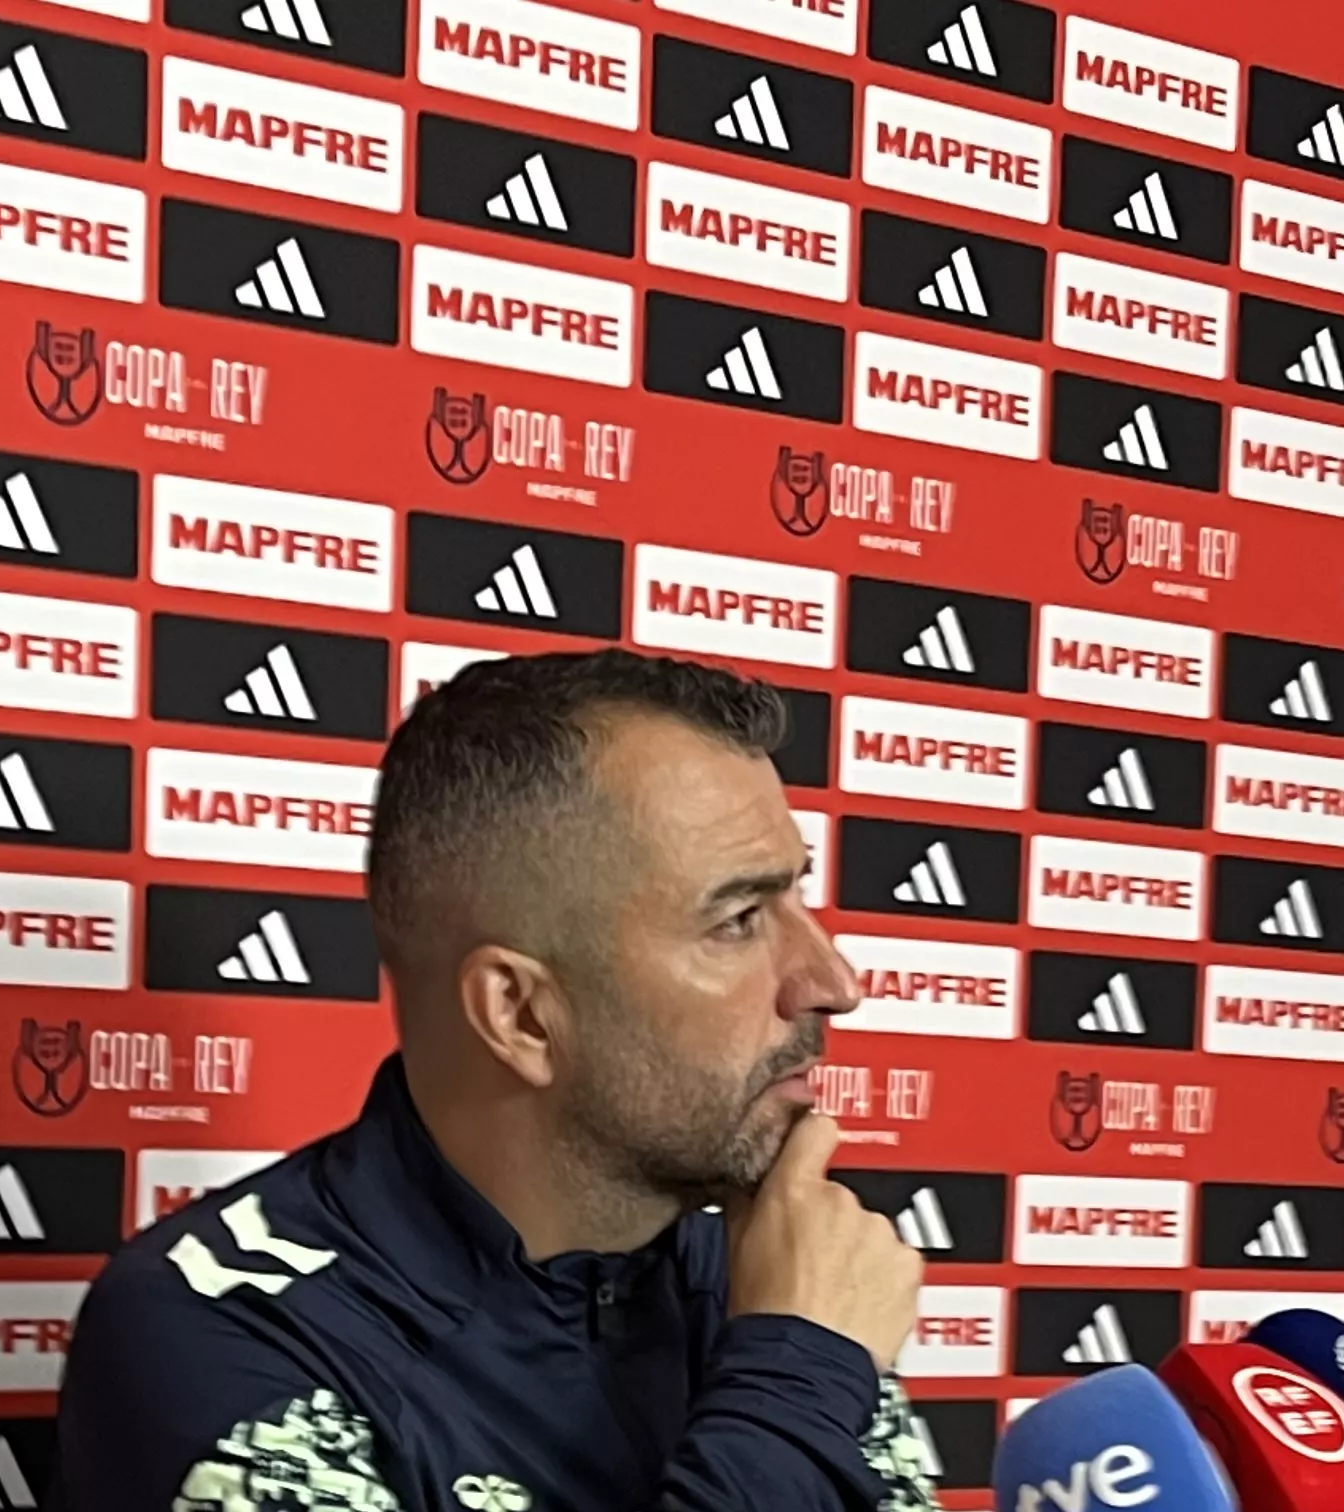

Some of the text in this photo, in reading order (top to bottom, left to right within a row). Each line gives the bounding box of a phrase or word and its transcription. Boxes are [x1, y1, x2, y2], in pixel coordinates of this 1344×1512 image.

[435, 18, 627, 93] MAPFRE
[1076, 51, 1228, 118] MAPFRE
[179, 98, 388, 173] MAPFRE
[877, 122, 1040, 189] MAPFRE
[661, 200, 838, 267] MAPFRE
[428, 284, 618, 350] MAPFRE
[1067, 287, 1217, 347] MAPFRE
[105, 341, 266, 424] COPA REY
[868, 367, 1029, 426] MAPFRE
[493, 406, 634, 481] COPA REY
[830, 463, 953, 532] COPA REY
[170, 514, 377, 574] MAPFRE
[1127, 514, 1236, 580] COPA REY
[649, 580, 823, 634] MAPFRE
[1052, 638, 1201, 687] MAPFRE
[854, 730, 1016, 777] MAPFRE
[164, 787, 374, 838] MAPFRE
[1042, 868, 1192, 910] MAPFRE
[90, 1030, 252, 1094] COPA REY
[808, 1065, 932, 1119] COPA REY
[1102, 1081, 1212, 1133] COPA REY
[1029, 1206, 1177, 1238] MAPFRE
[916, 1317, 992, 1346] FRE
